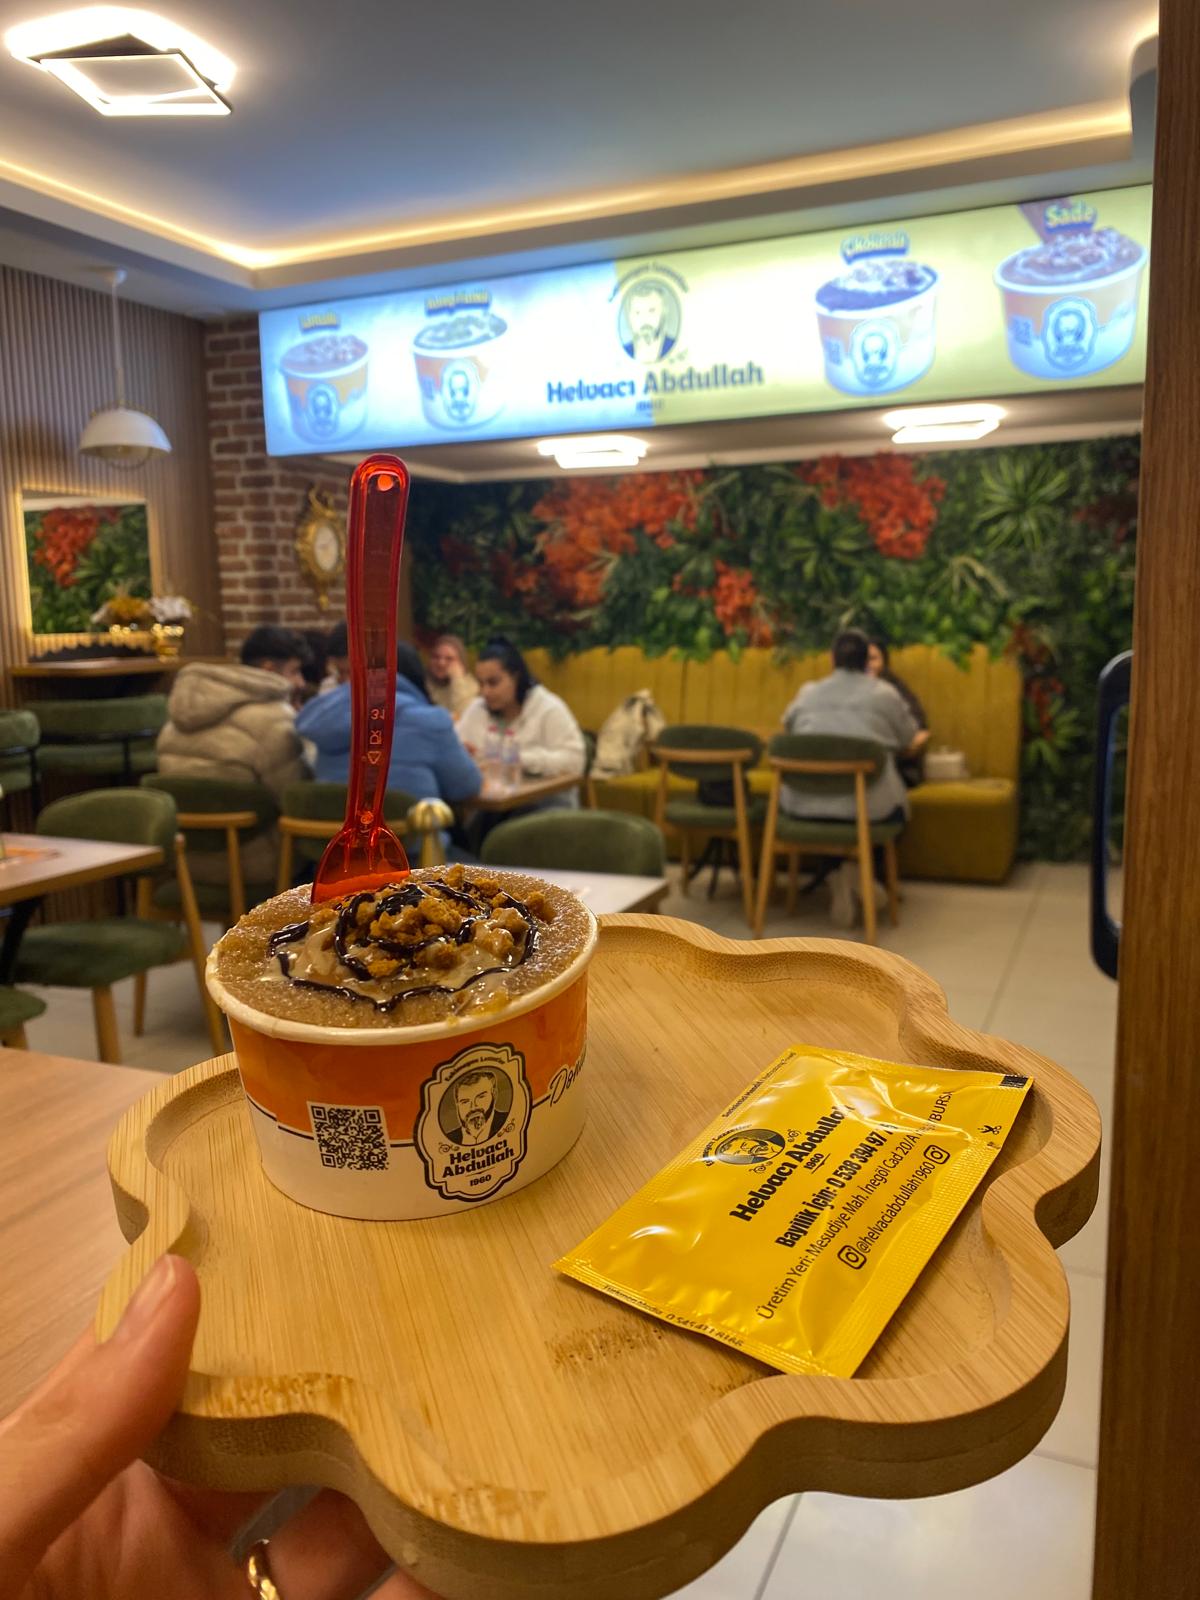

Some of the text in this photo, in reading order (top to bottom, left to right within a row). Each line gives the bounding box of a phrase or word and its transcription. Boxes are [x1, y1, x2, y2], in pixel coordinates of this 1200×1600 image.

[643, 360, 764, 396] Abdullah
[442, 1147, 515, 1179] Abdullah
[449, 1139, 508, 1165] Helvacı
[803, 1153, 825, 1170] 1960
[469, 1174, 492, 1187] 1960
[729, 1161, 798, 1221] Helvacı
[774, 1130, 888, 1248] Bayilik İçin: 0 538 394 97
[855, 1161, 936, 1254] @helvaciabdullah1960
[755, 1276, 798, 1319] Üretim
[786, 1255, 816, 1277] Yeri:
[805, 1211, 851, 1257] Mesudiye
[841, 1193, 870, 1216] Mah.
[857, 1164, 891, 1195] İnegöl
[882, 1151, 904, 1170] Cad
[896, 1134, 920, 1156] 20/A
